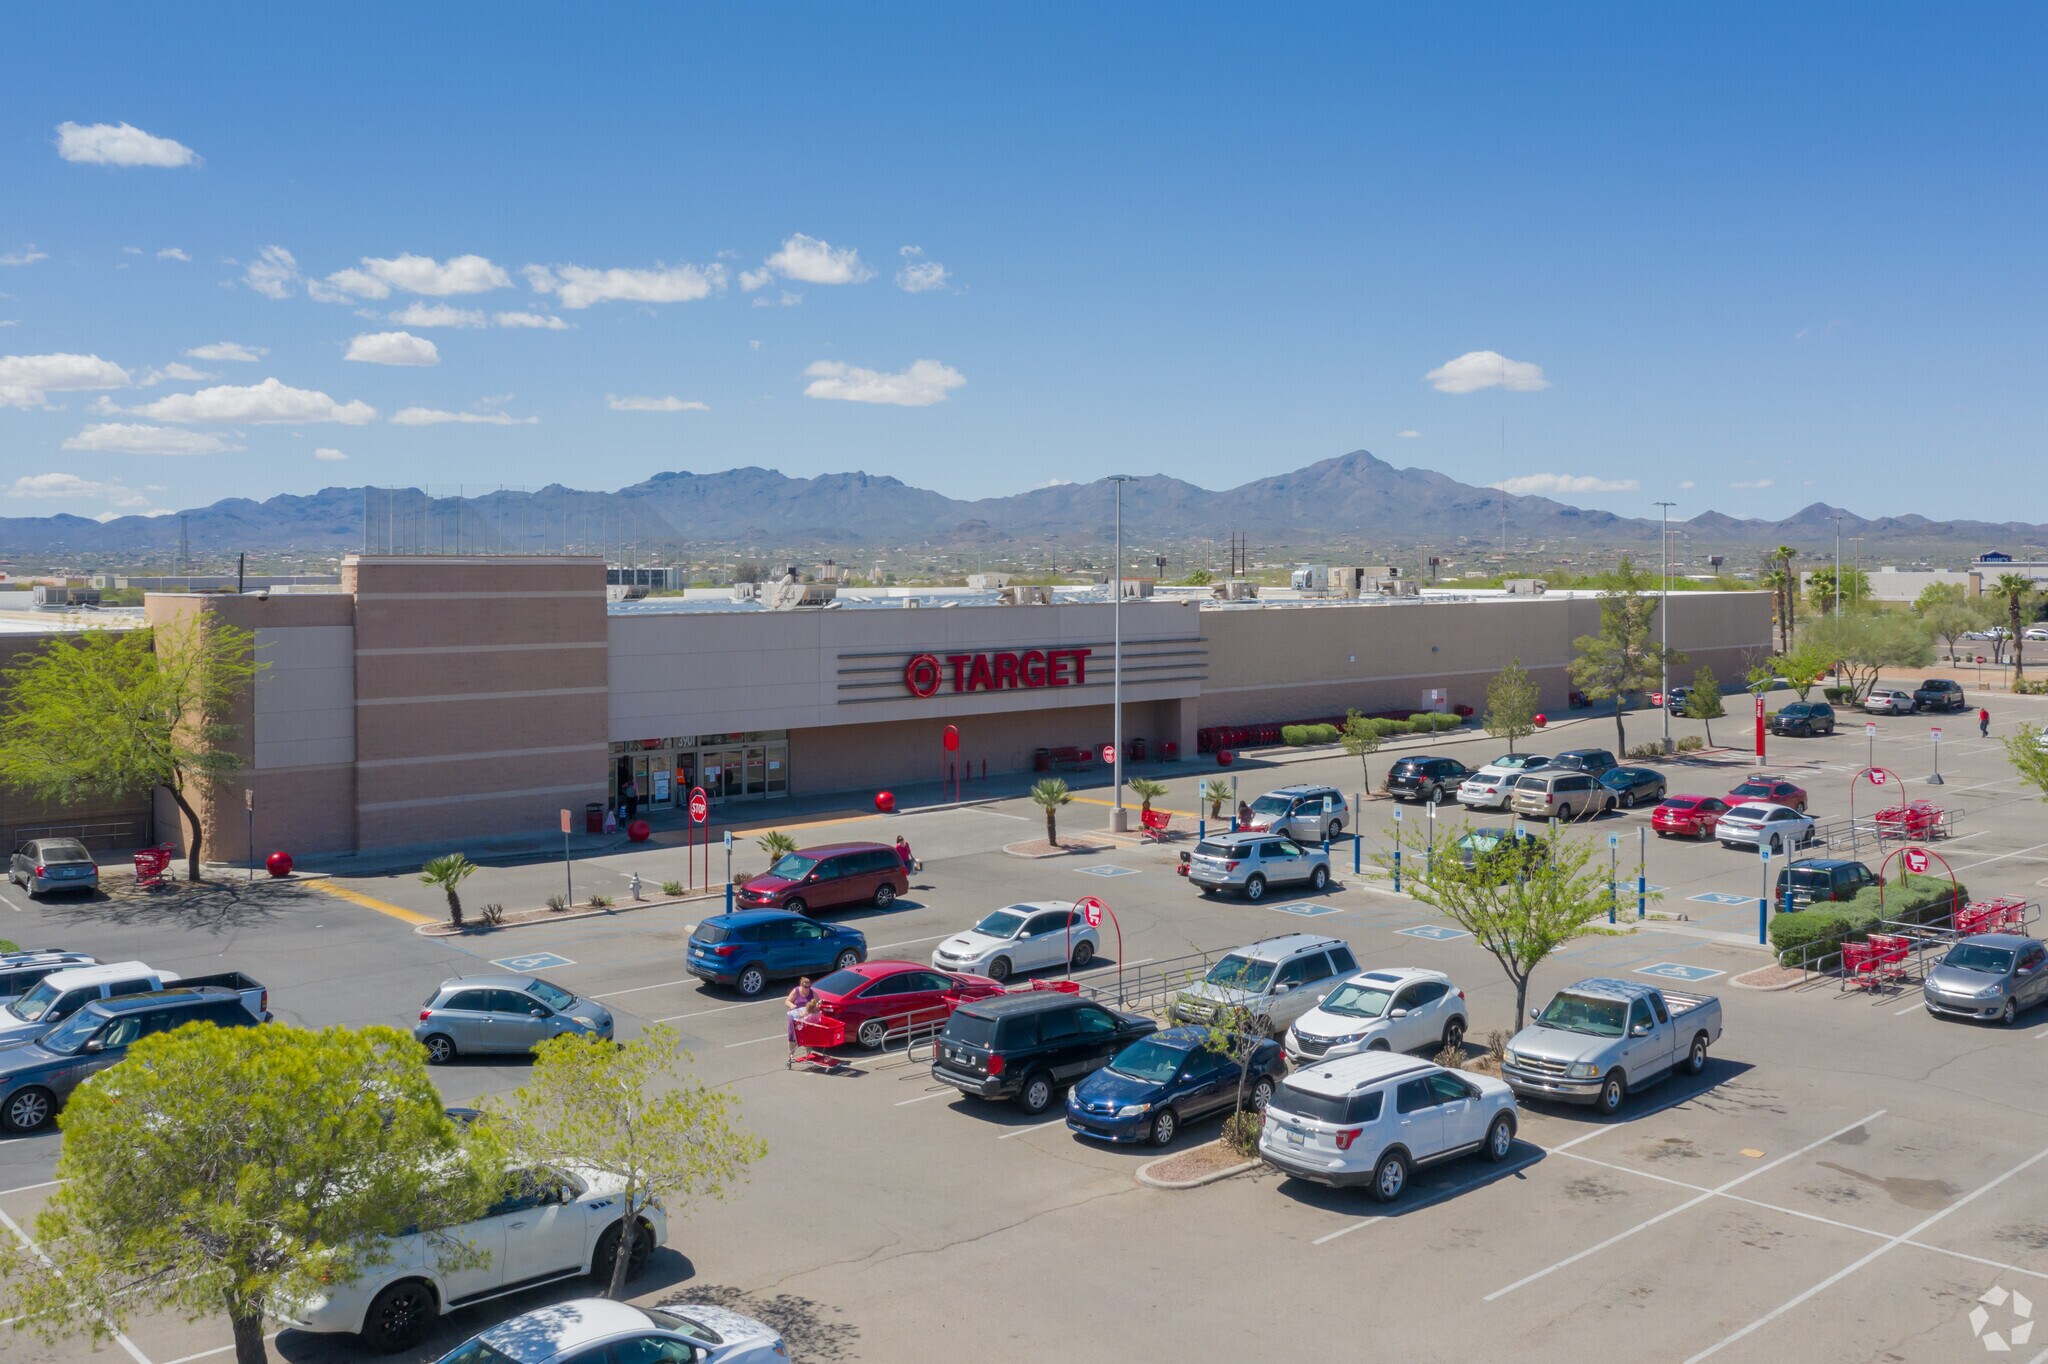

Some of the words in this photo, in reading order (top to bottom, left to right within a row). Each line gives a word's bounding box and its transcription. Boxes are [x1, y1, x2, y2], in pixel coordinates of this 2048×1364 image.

[947, 649, 1092, 692] TARGET
[678, 735, 696, 747] 3901
[692, 803, 705, 814] STOP
